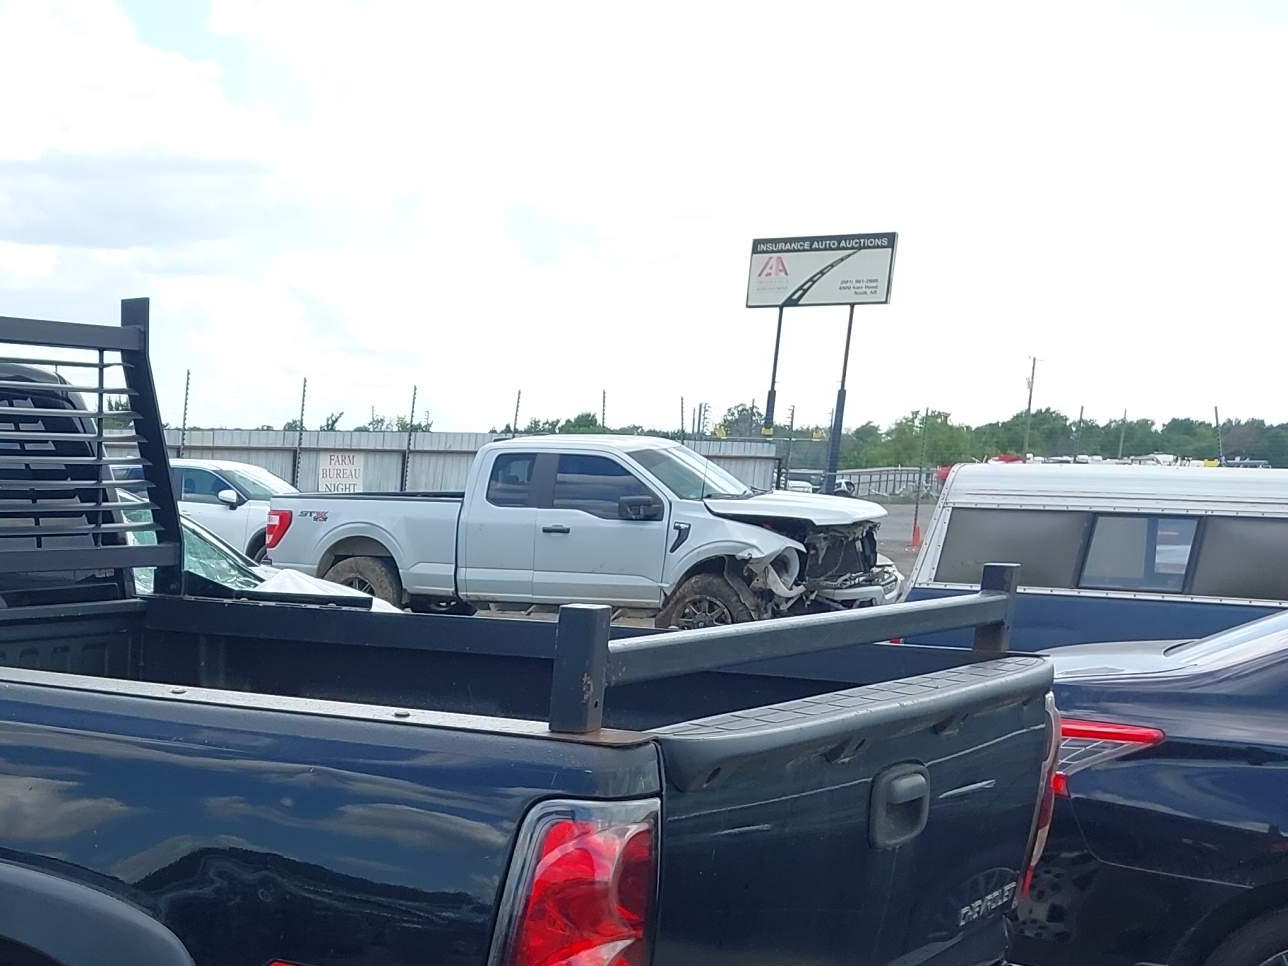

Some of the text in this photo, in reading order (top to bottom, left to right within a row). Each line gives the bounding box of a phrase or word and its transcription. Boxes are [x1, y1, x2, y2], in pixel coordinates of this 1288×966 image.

[757, 238, 888, 251] INSURANCE AUTO AUCTIONS
[329, 454, 355, 466] FARM
[322, 468, 361, 479] BUREAU
[324, 483, 357, 493] NIGHT
